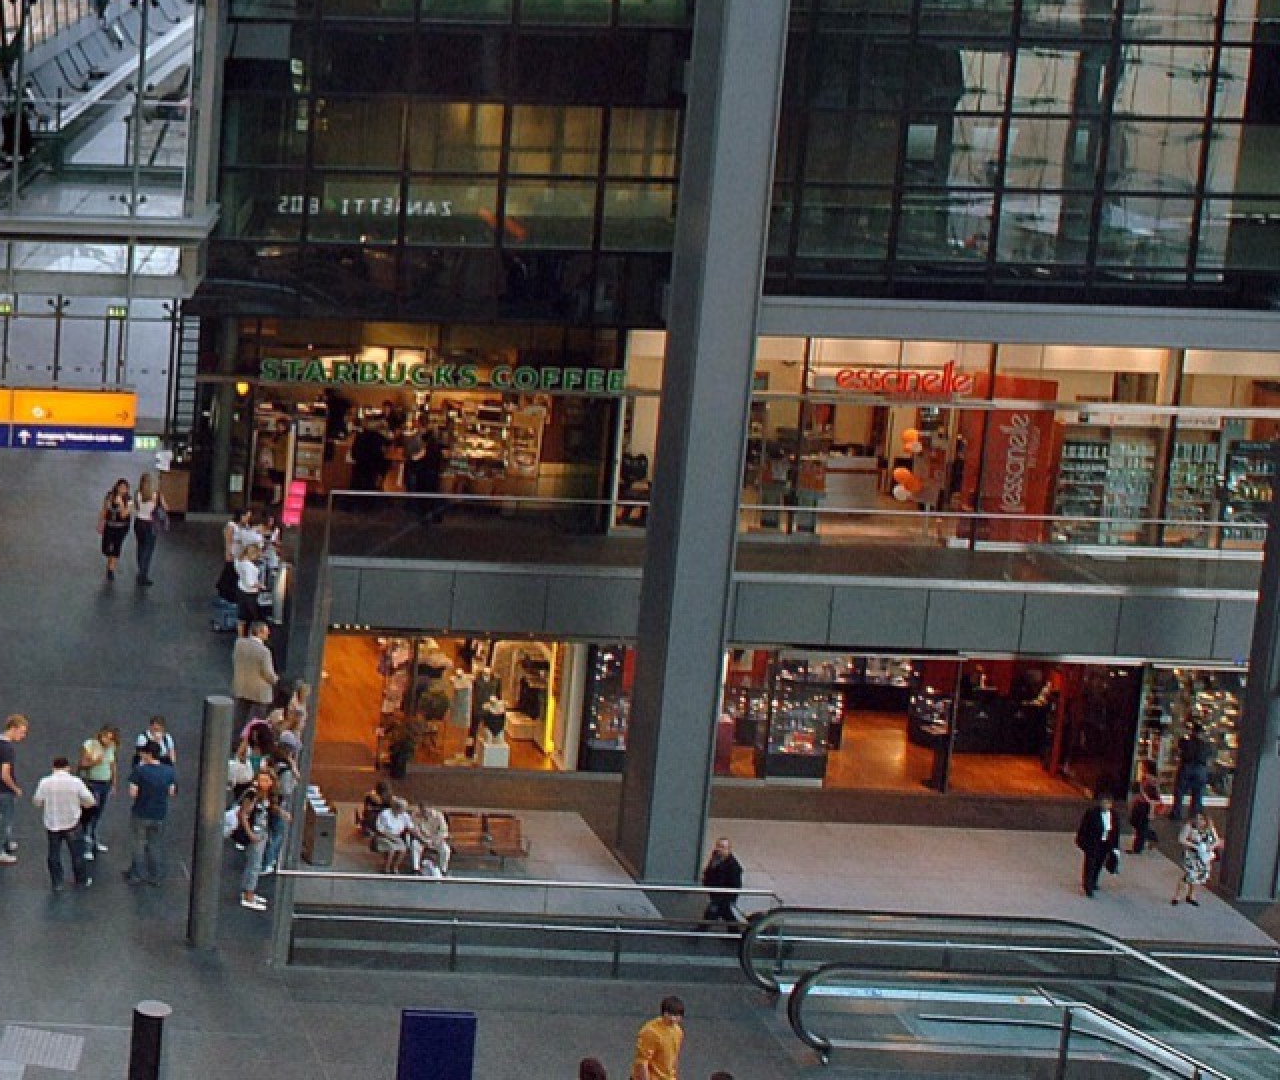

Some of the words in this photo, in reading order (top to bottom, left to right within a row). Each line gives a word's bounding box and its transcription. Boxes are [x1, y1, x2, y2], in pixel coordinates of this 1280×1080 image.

[260, 357, 478, 387] STARBUCKS
[491, 365, 628, 393] COFFEE
[835, 360, 973, 394] essanelle
